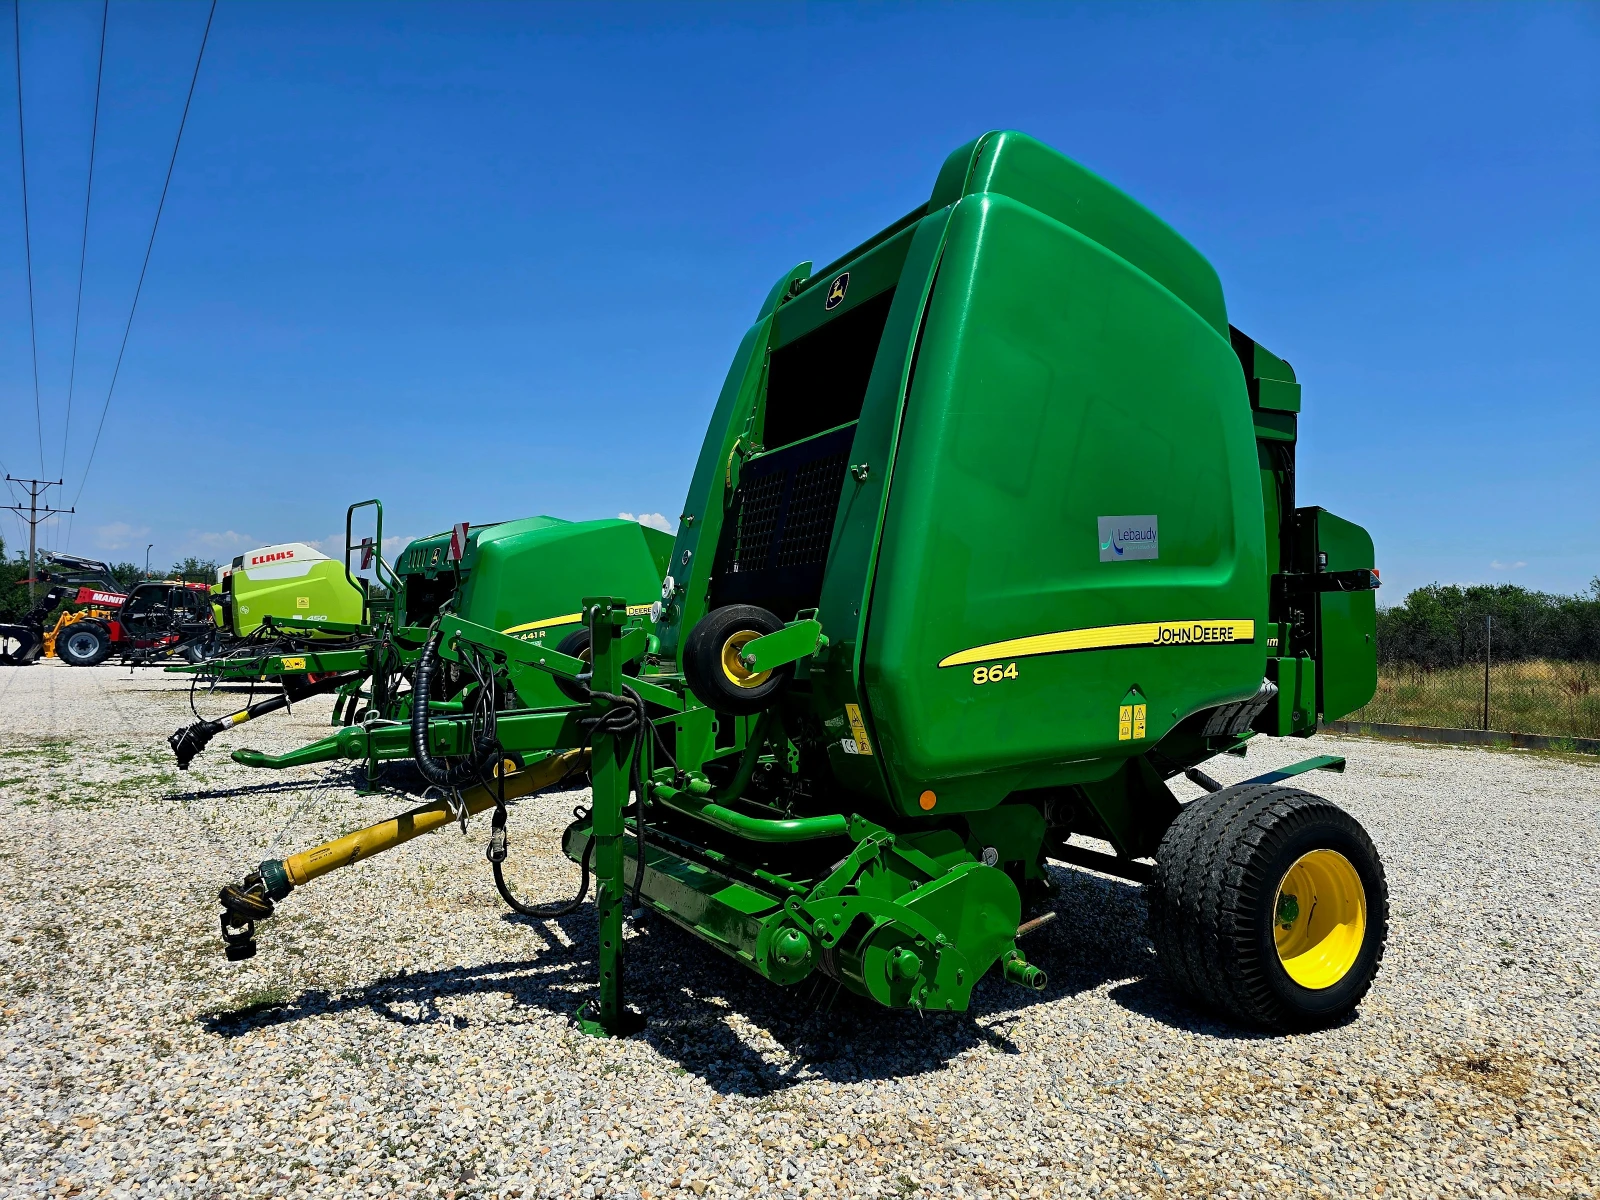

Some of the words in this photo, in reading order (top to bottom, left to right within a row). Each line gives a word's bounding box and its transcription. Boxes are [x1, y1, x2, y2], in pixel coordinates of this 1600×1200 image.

[1117, 526, 1157, 543] Lebaudy
[251, 550, 294, 565] CLAAS
[92, 592, 126, 604] MANIT
[1153, 626, 1191, 643] JOHN
[1193, 624, 1234, 641] DEERE
[973, 662, 1019, 685] 864
